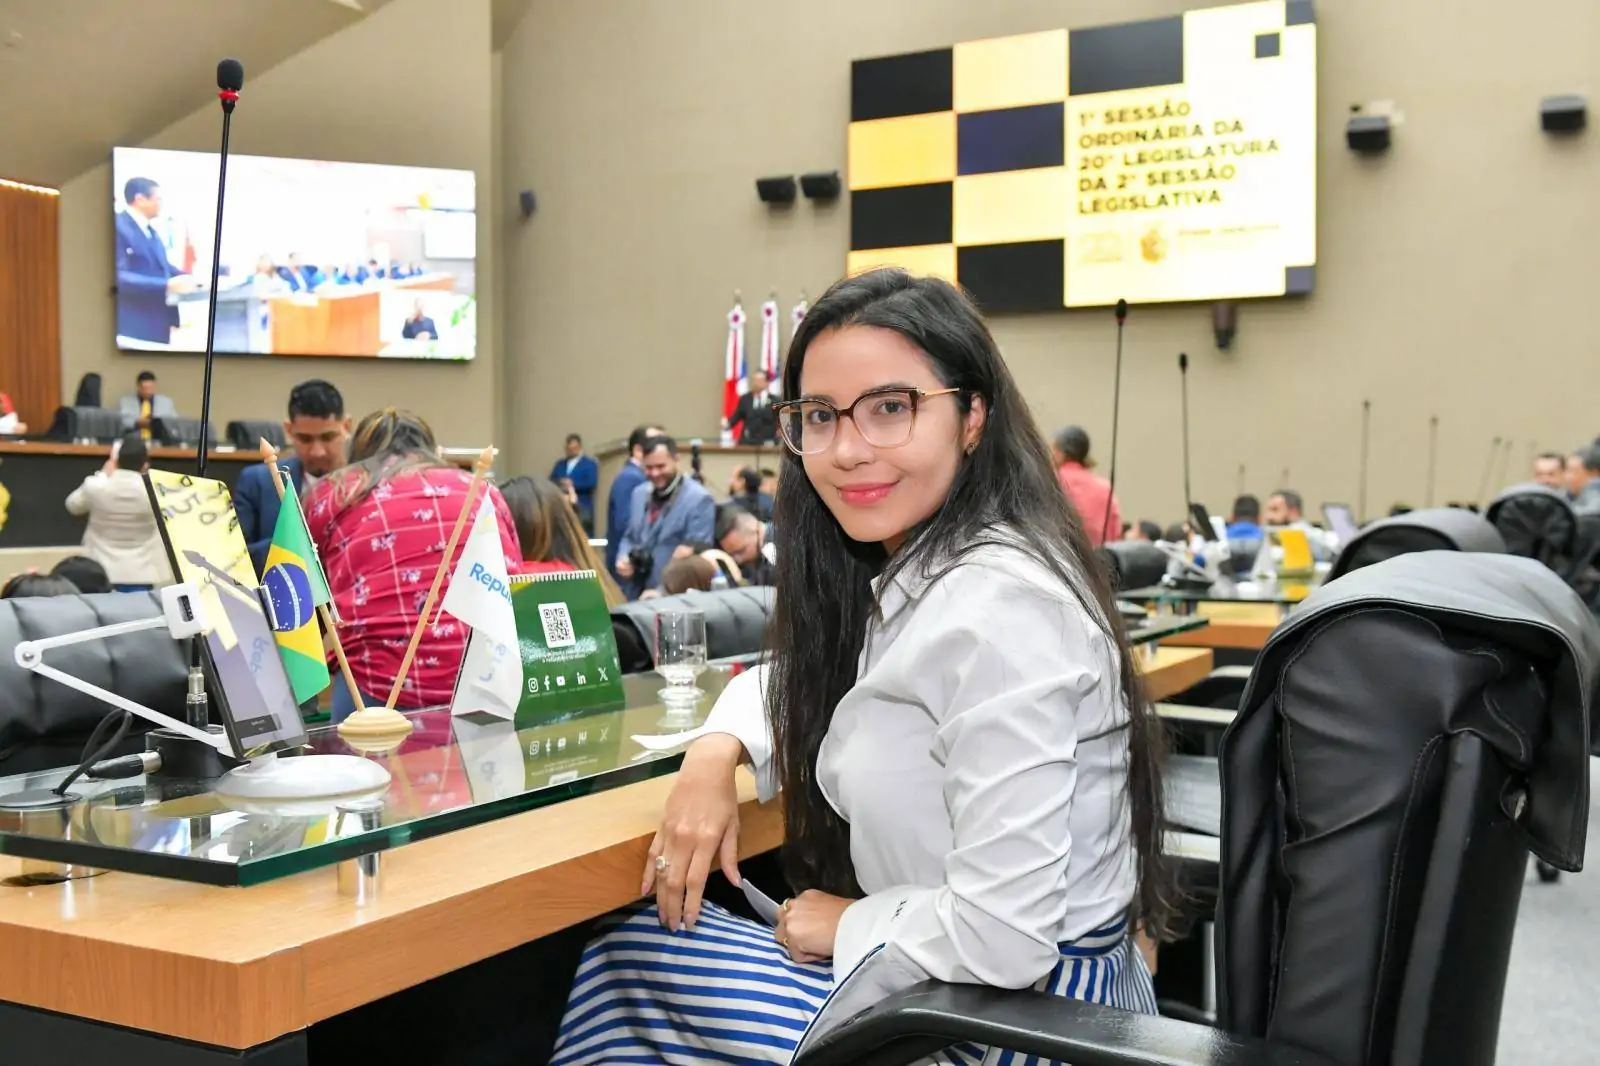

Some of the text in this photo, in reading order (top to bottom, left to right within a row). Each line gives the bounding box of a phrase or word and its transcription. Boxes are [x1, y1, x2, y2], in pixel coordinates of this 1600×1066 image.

[1103, 99, 1191, 125] SESSÃO
[1079, 119, 1243, 149] ORDINÁRIA DA
[1123, 139, 1279, 166] LEGISLATURA
[1079, 176, 1108, 192] DA
[1147, 162, 1236, 187] SESSÃO
[1079, 189, 1221, 215] LEGISLATIVA
